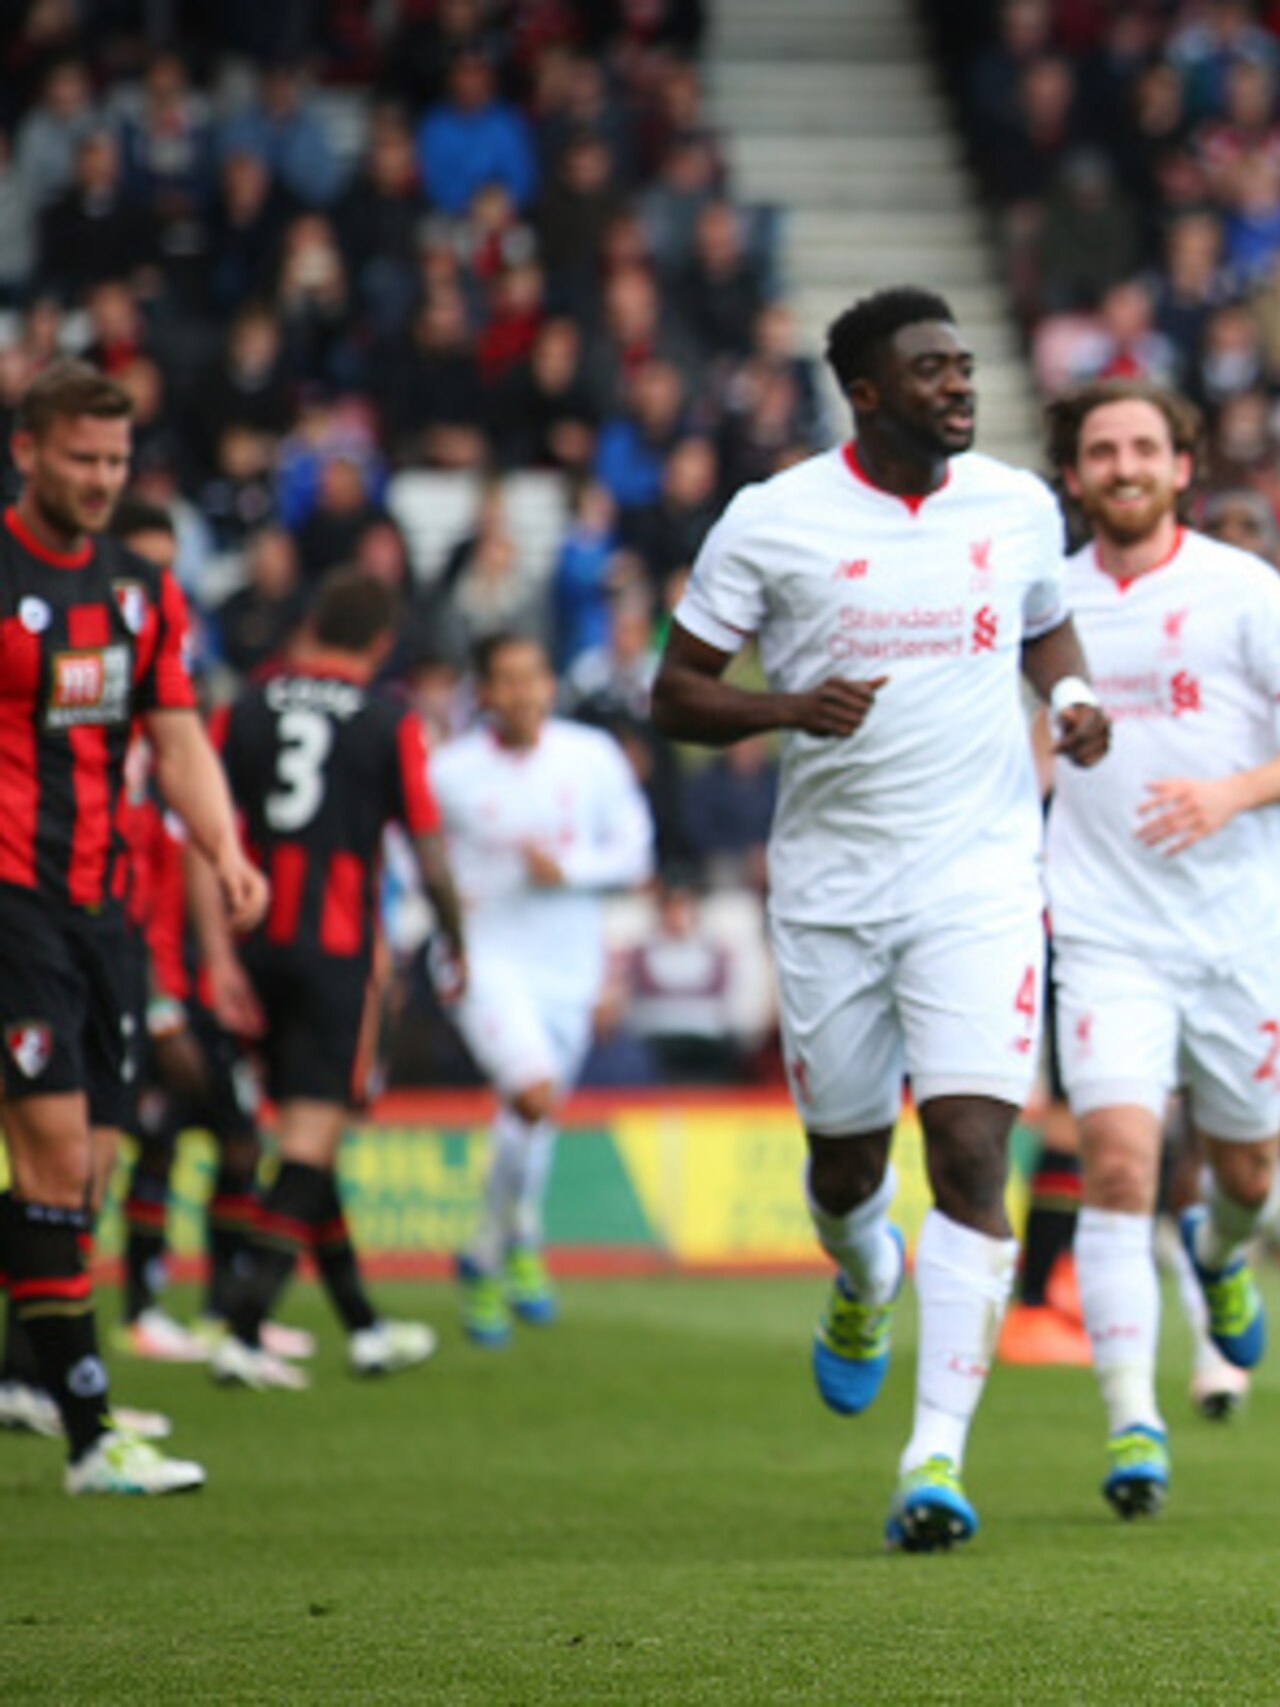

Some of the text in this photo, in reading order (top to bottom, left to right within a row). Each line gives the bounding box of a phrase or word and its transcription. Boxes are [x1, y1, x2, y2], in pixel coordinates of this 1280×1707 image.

[838, 606, 963, 631] Standard
[264, 706, 333, 831] 3
[1013, 964, 1036, 1028] 4
